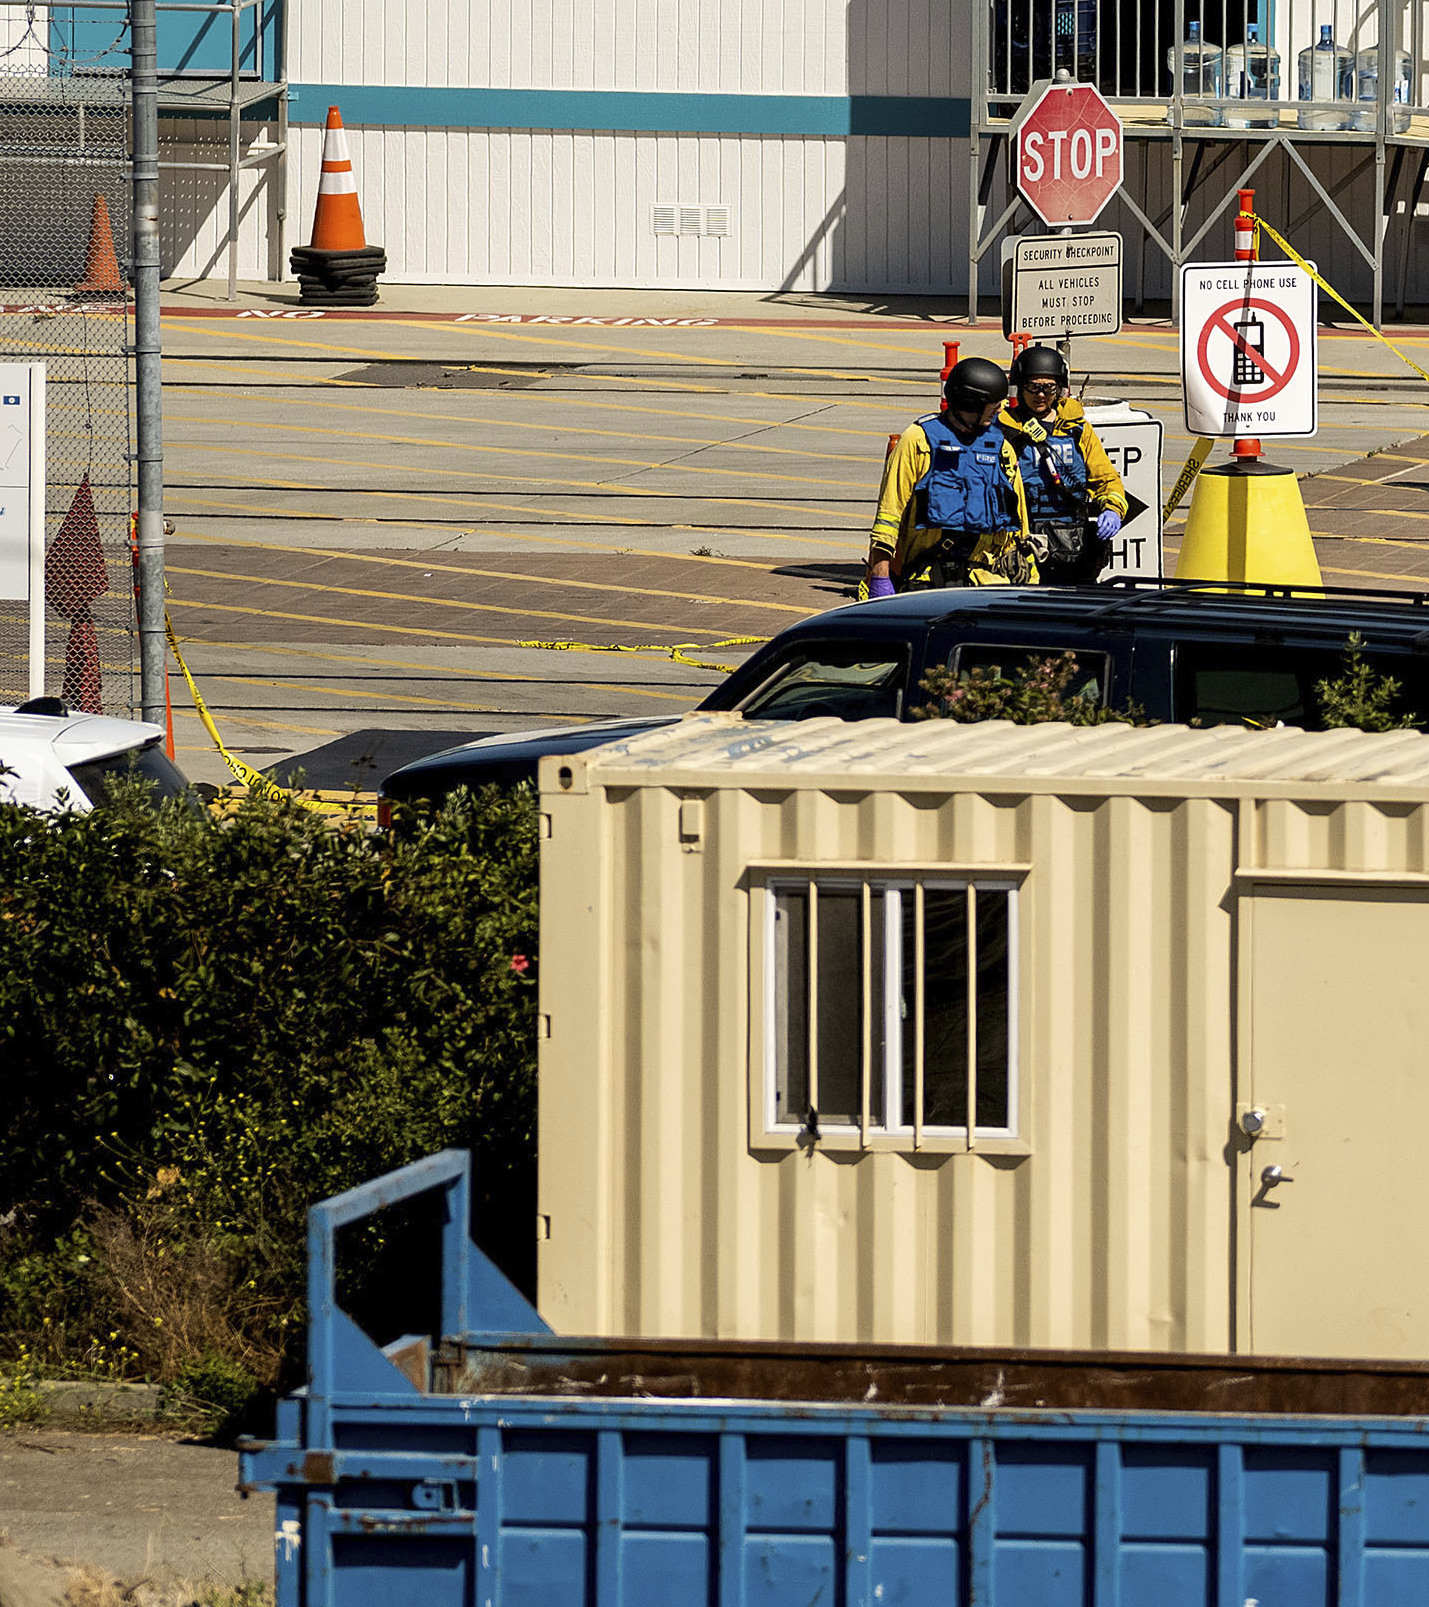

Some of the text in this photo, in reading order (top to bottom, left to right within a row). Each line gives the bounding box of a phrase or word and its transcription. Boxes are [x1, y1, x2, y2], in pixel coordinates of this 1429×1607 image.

[1023, 128, 1117, 182] STOP
[1024, 246, 1114, 261] SECURITY CHECKPOINT
[1038, 277, 1100, 290] ALL VEHICLES
[1200, 278, 1297, 290] NO CELL PHONE USE
[1042, 295, 1095, 308] MUST STOP
[236, 310, 720, 326] NO PARKING
[1022, 314, 1112, 328] BEFORE PROCEEDING
[1223, 411, 1276, 423] THANK YOU
[976, 454, 996, 463] FIRE
